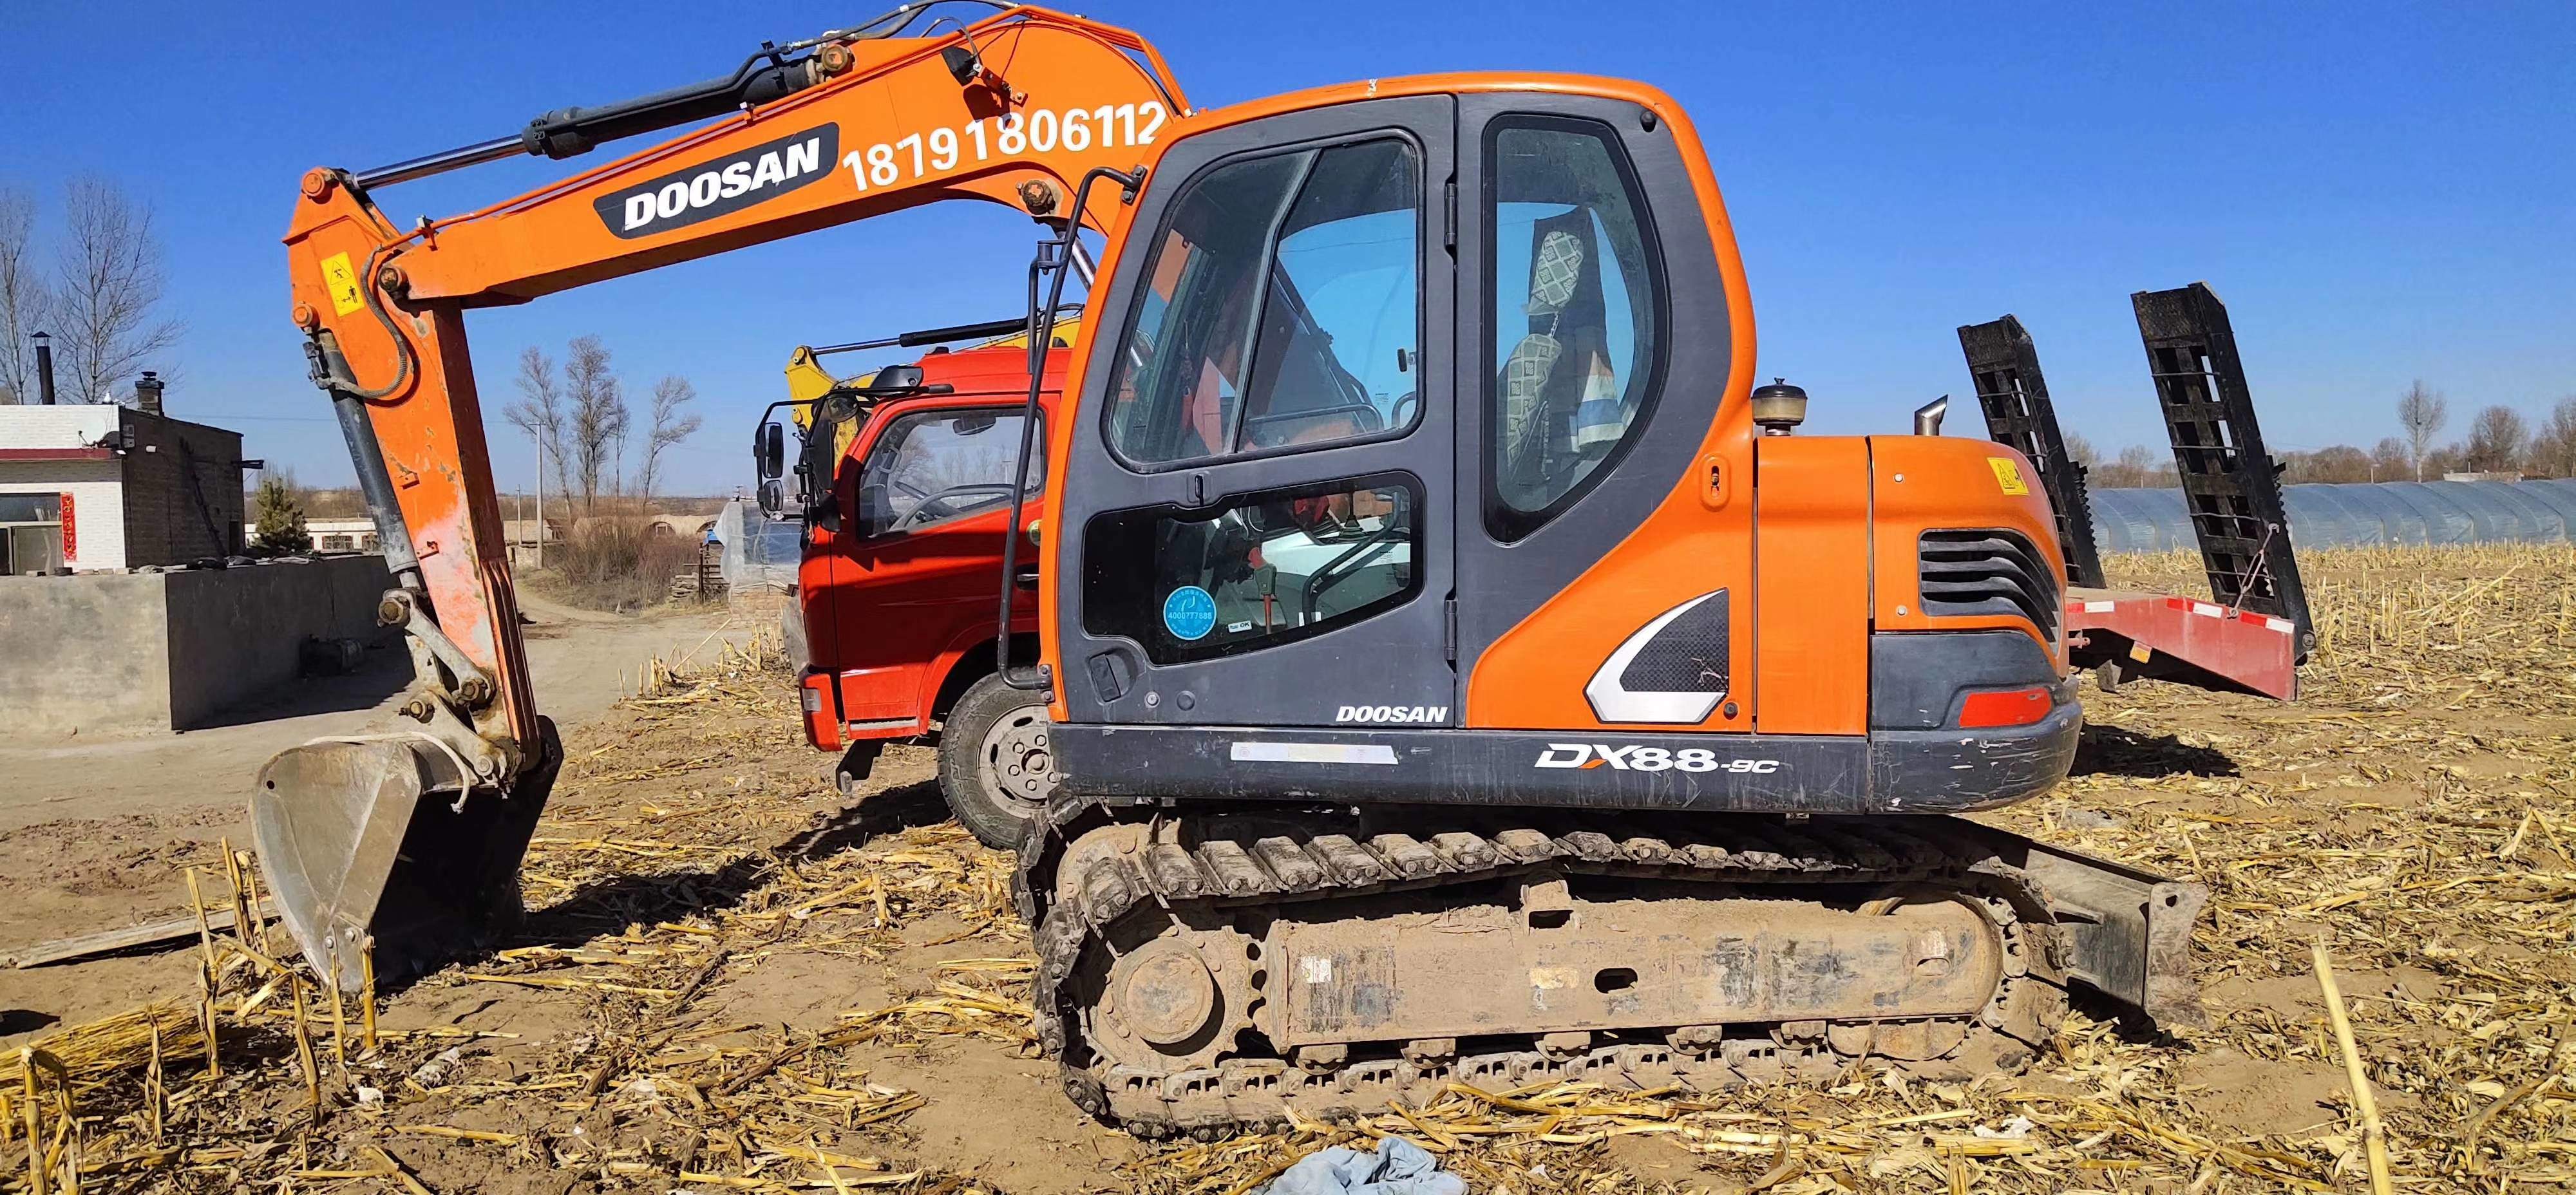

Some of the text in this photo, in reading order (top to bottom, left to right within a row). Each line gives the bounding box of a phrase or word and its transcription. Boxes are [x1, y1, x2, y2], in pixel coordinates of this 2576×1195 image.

[624, 136, 820, 231] DOOSAN
[842, 100, 1168, 192] 18791806112
[1335, 706, 1448, 722] DOOSAN
